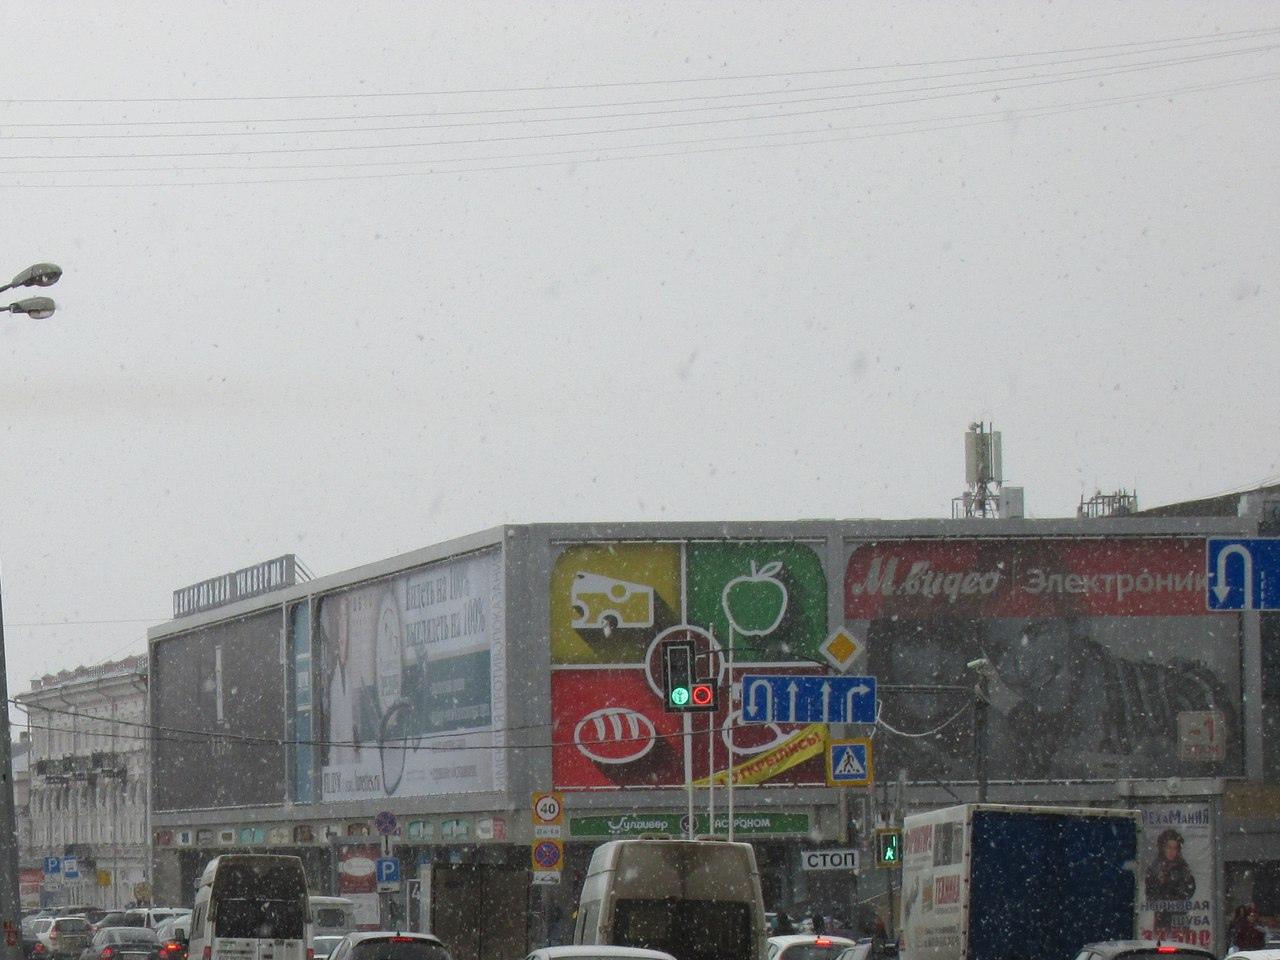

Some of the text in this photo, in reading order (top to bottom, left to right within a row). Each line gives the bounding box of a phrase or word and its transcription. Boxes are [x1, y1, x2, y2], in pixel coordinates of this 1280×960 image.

[540, 802, 556, 815] 40
[711, 818, 771, 830] АСРОНОМ
[807, 852, 855, 868] СТОП
